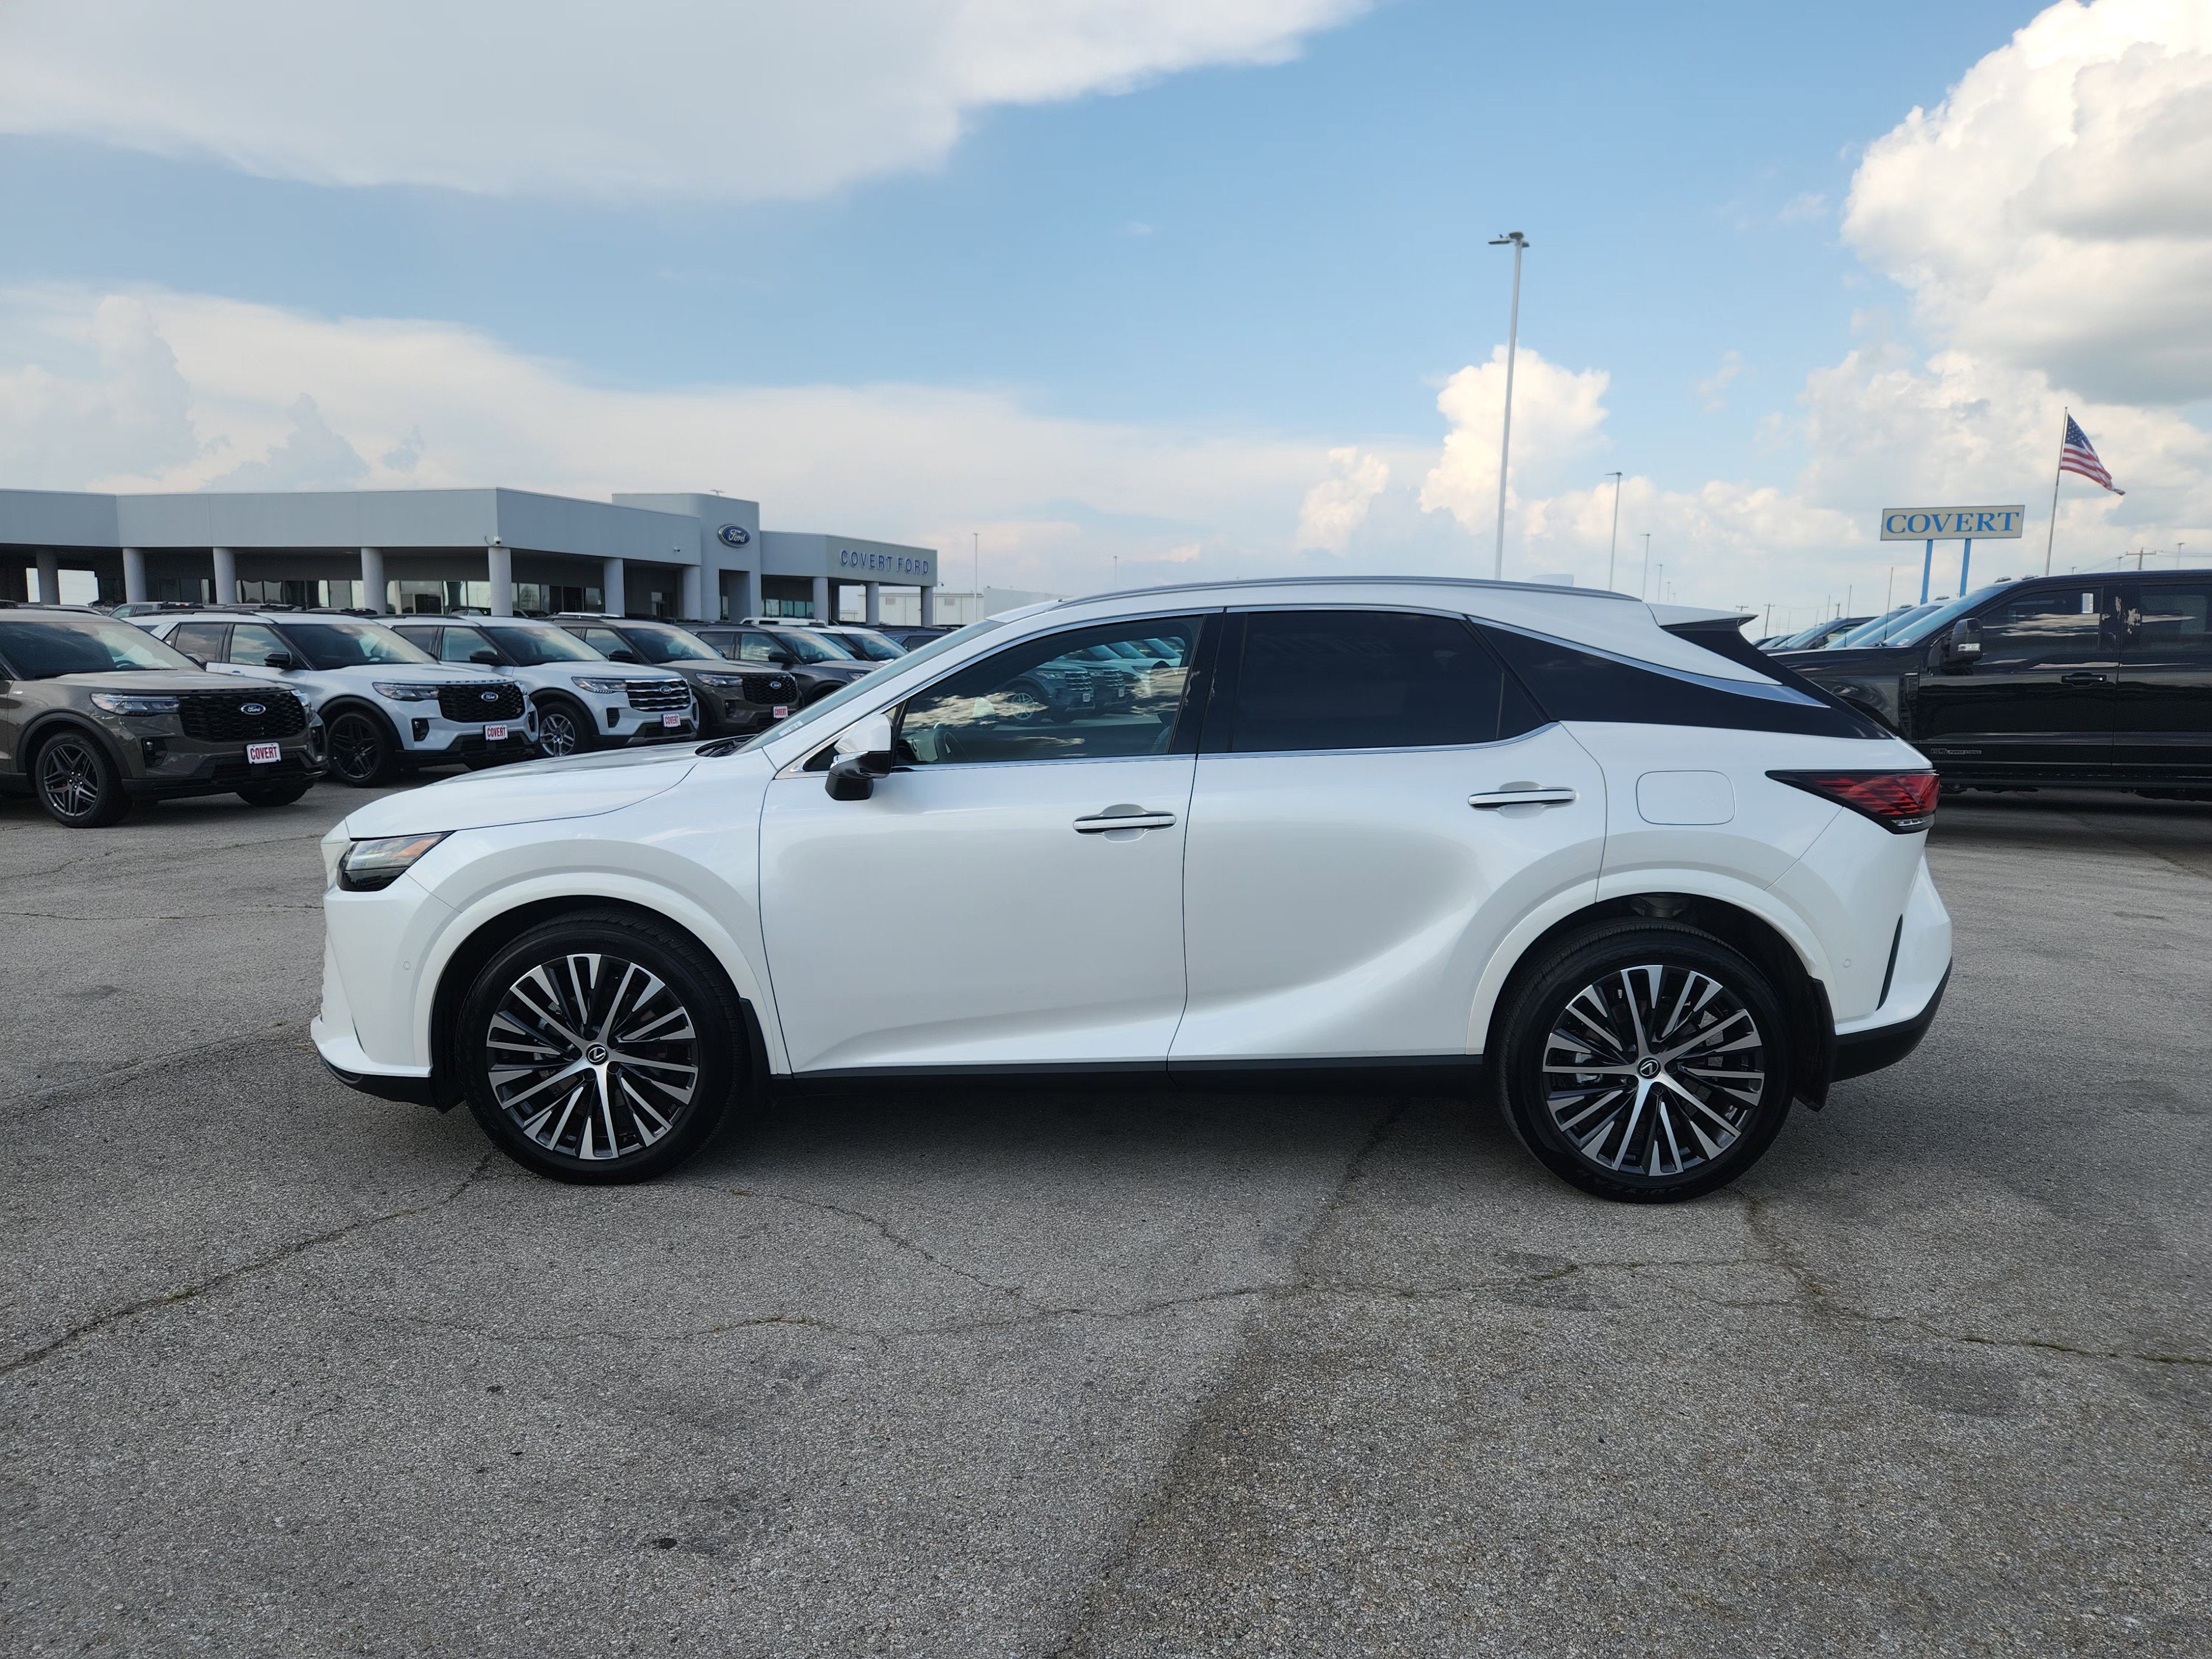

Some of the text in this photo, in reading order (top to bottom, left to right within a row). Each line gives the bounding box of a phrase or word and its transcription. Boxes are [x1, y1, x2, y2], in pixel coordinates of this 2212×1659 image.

[1886, 512, 2020, 534] COVERT
[728, 529, 746, 542] Ford
[841, 550, 929, 574] COVERT FORD
[665, 716, 679, 725] COVERT
[487, 727, 506, 738] COVERT
[250, 746, 277, 760] COVERT
